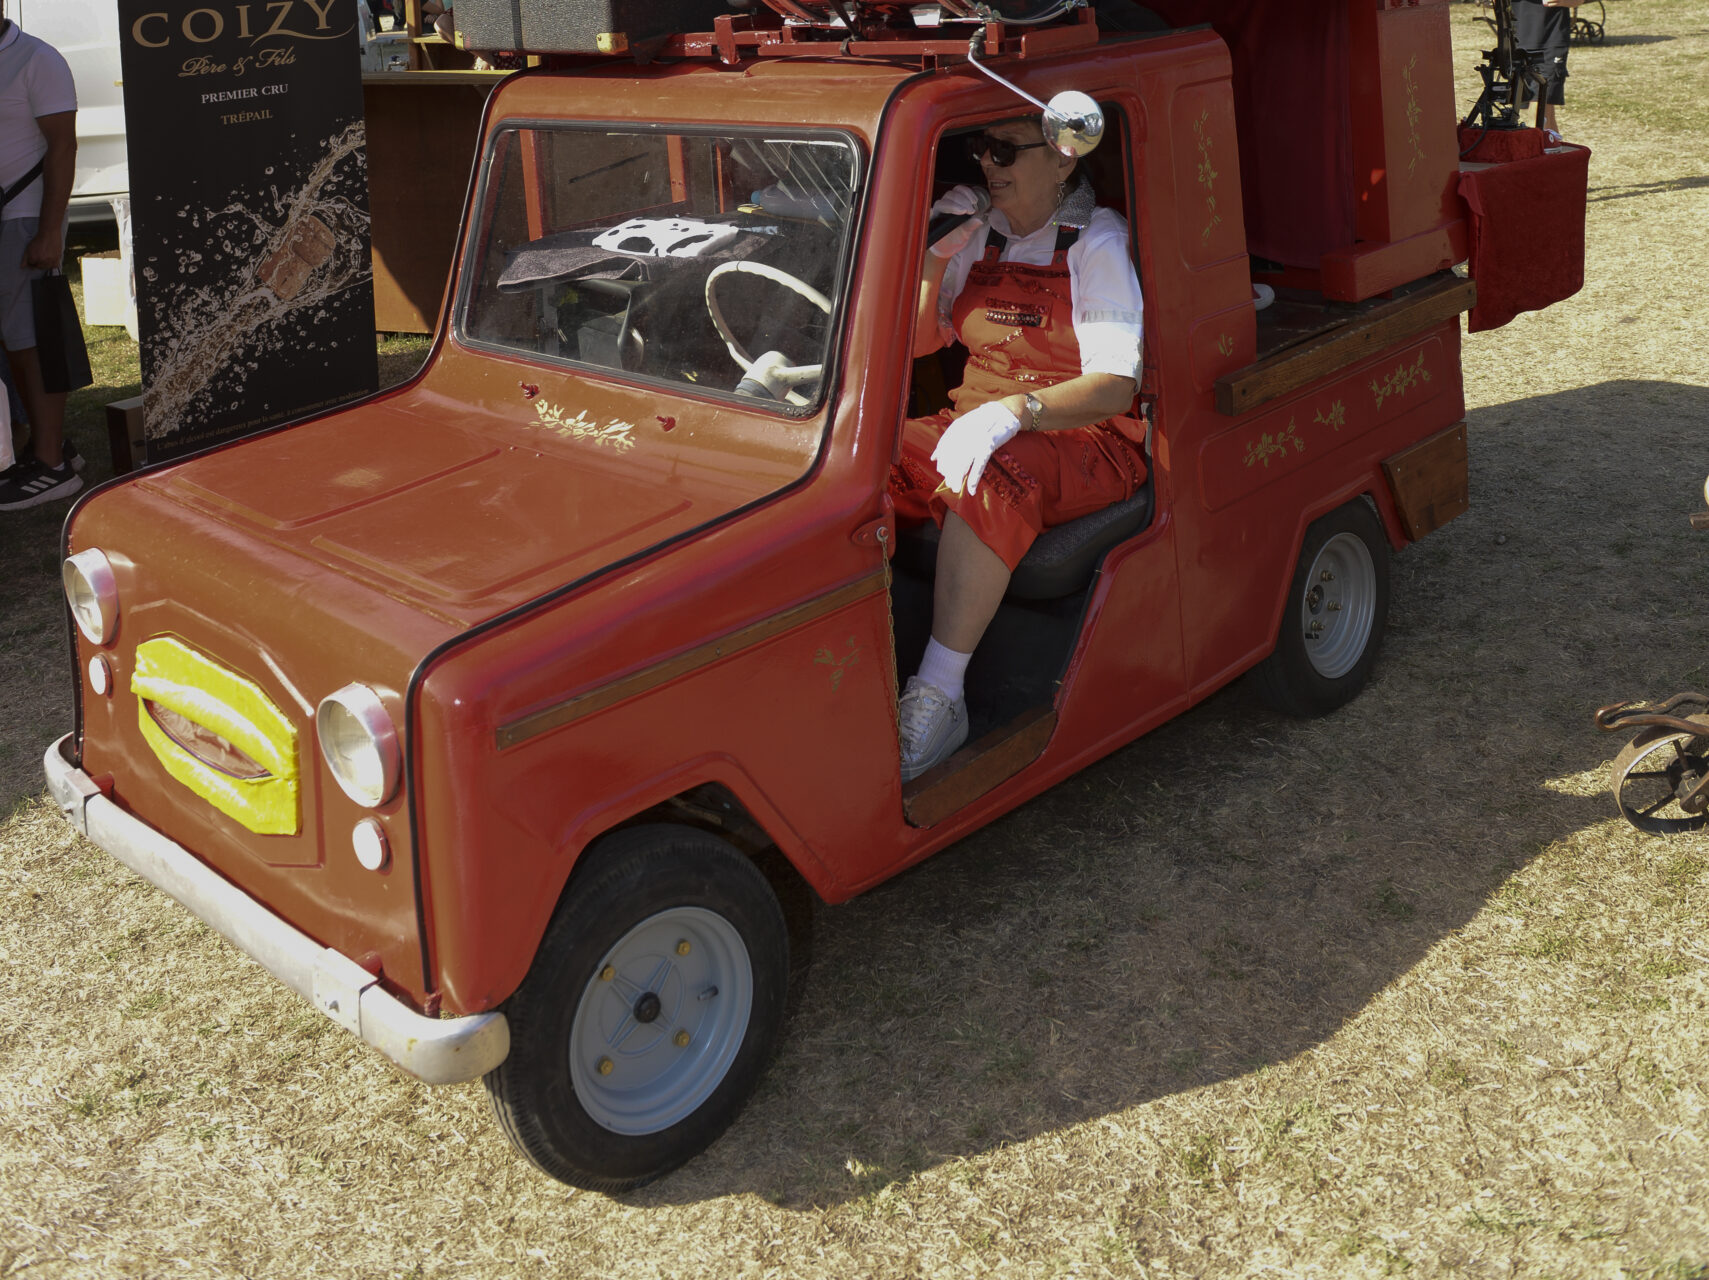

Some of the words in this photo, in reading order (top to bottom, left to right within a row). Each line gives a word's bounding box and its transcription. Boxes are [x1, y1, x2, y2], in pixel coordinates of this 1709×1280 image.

[178, 55, 227, 77] Père
[233, 56, 253, 76] &
[256, 46, 296, 68] Fils
[201, 87, 259, 104] PREMIER
[262, 83, 289, 96] CRU
[221, 109, 273, 126] TRÉPAIL
